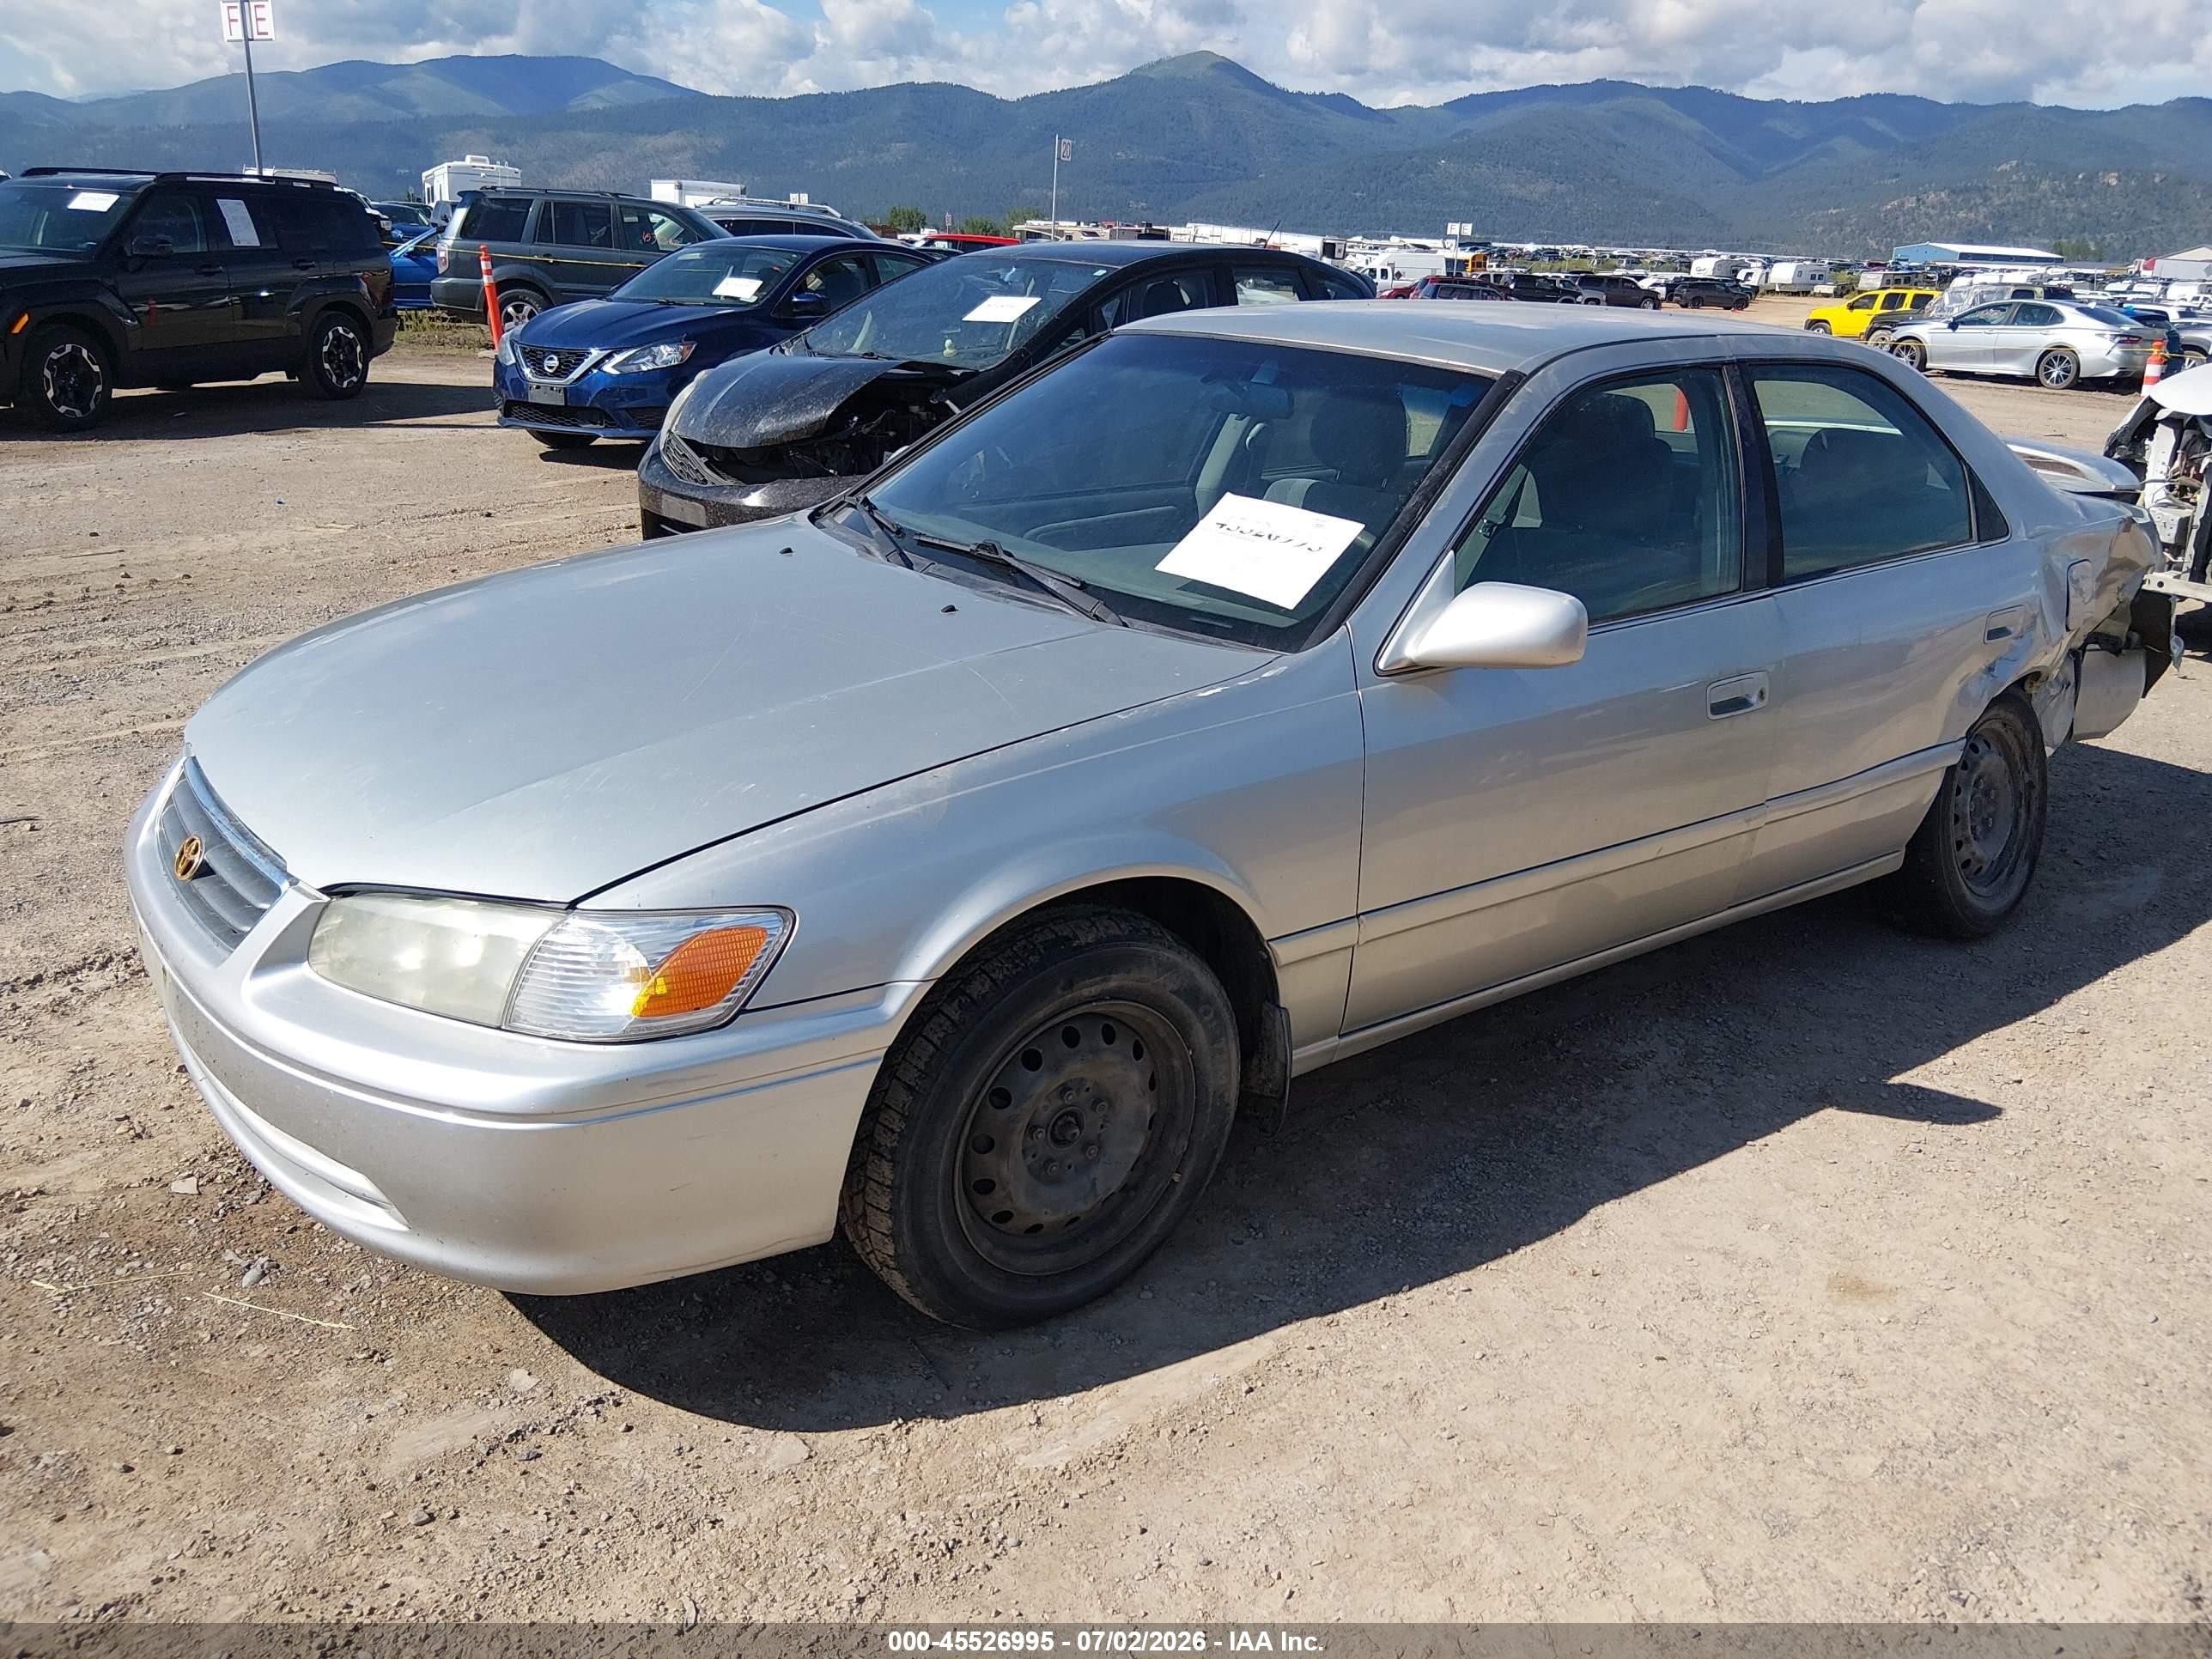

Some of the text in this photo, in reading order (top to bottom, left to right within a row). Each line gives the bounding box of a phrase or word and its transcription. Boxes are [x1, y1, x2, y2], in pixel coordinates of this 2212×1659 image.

[227, 4, 269, 36] F E
[1061, 141, 1071, 159] 20
[1449, 224, 1469, 234] F E
